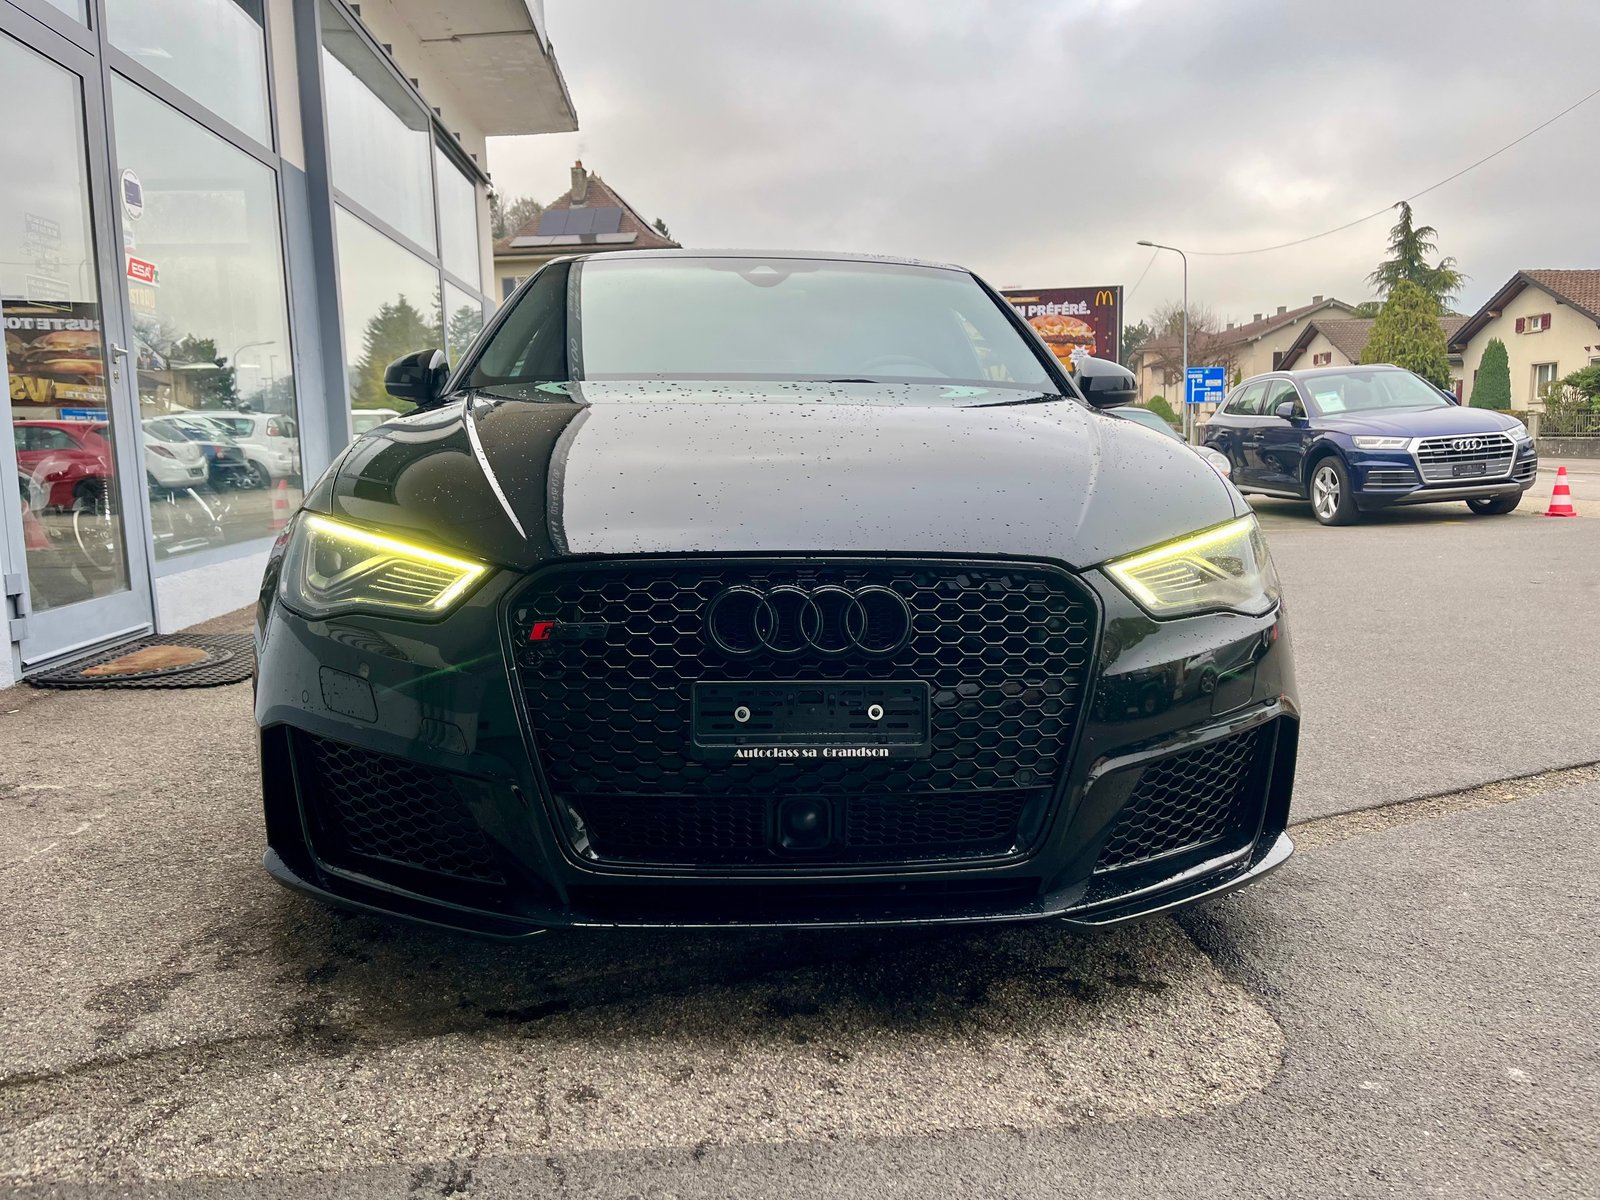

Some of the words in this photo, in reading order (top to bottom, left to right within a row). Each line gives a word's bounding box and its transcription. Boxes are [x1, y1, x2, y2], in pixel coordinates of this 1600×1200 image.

[132, 264, 153, 278] ESA
[1028, 300, 1091, 317] PRÉFÉRÉ.
[735, 747, 800, 758] Autoclass
[802, 747, 818, 758] sa
[823, 747, 890, 758] Grandson
